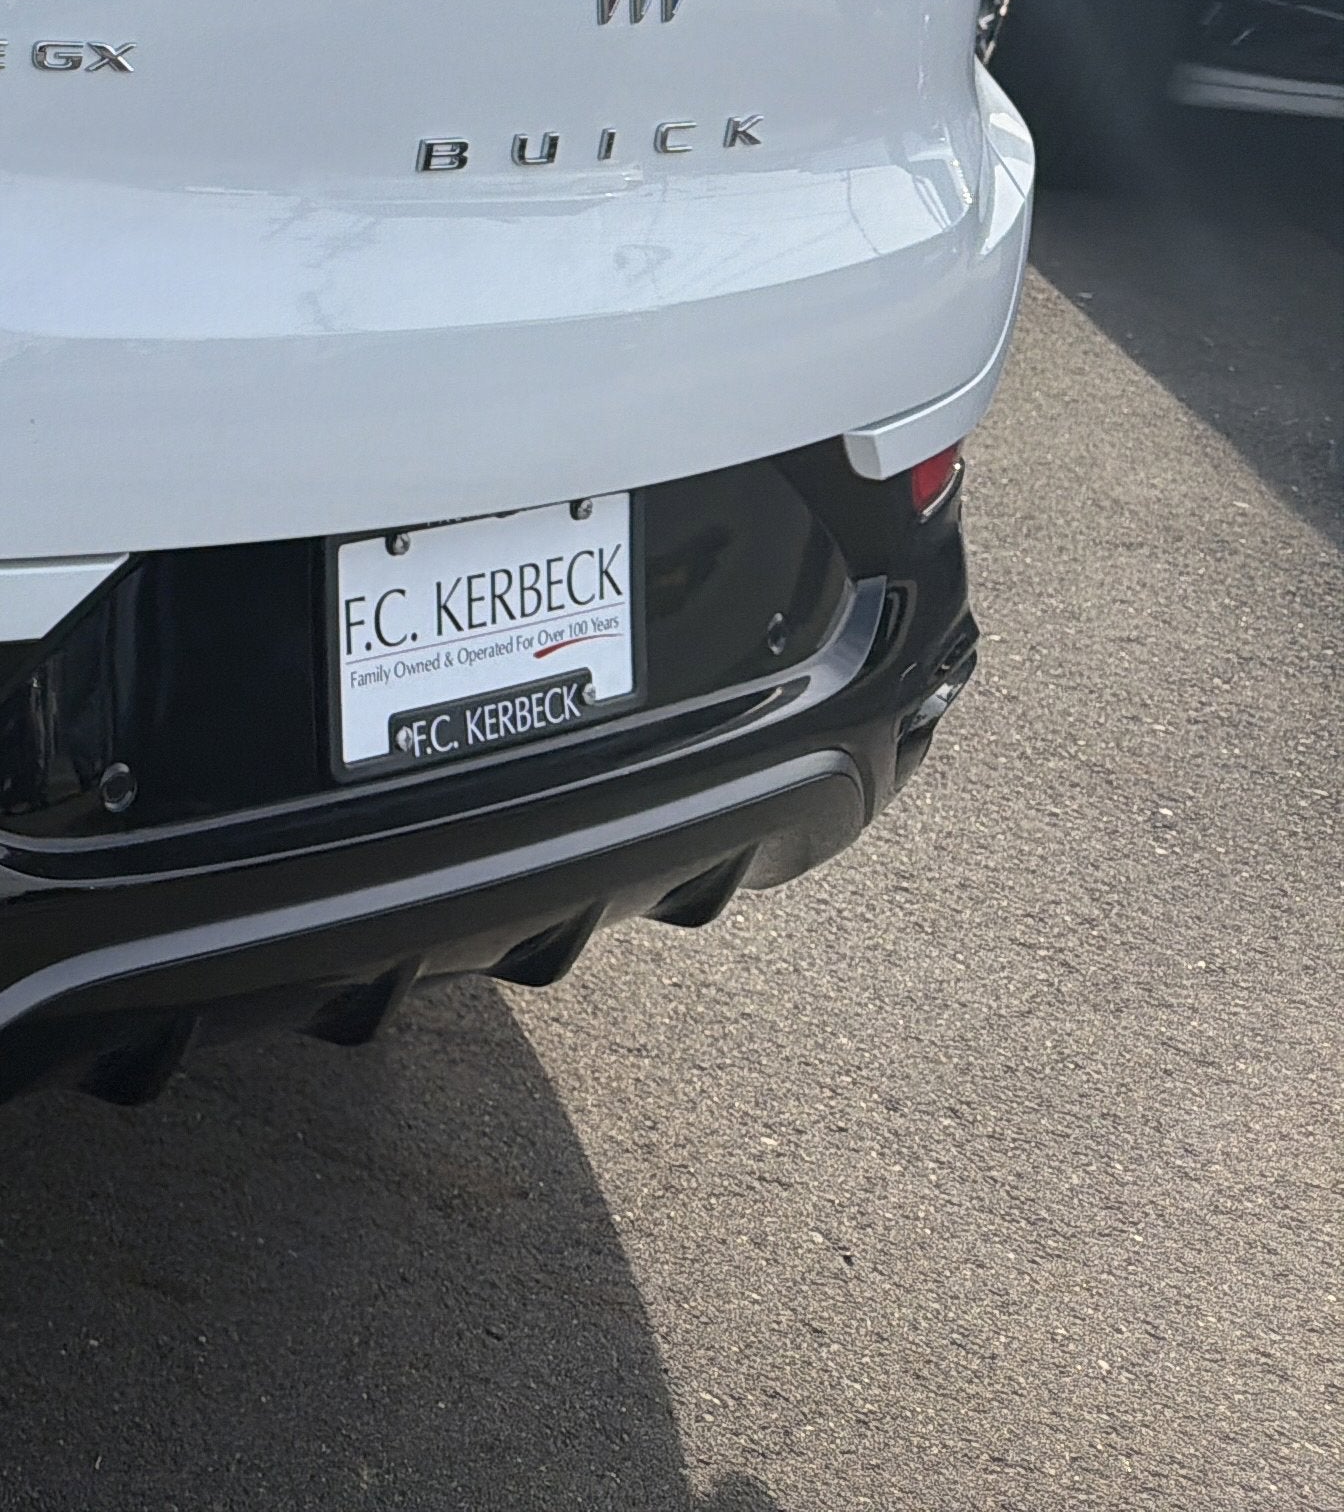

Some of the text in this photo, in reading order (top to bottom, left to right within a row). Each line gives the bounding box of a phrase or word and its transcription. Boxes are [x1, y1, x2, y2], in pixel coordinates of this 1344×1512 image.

[31, 39, 138, 73] GX
[415, 114, 765, 173] BUICK
[344, 543, 623, 656] F.C. KERBECK
[350, 615, 620, 689] Family Owned & Operated For Over 100 Years
[412, 683, 581, 758] F.C. KERBECK
